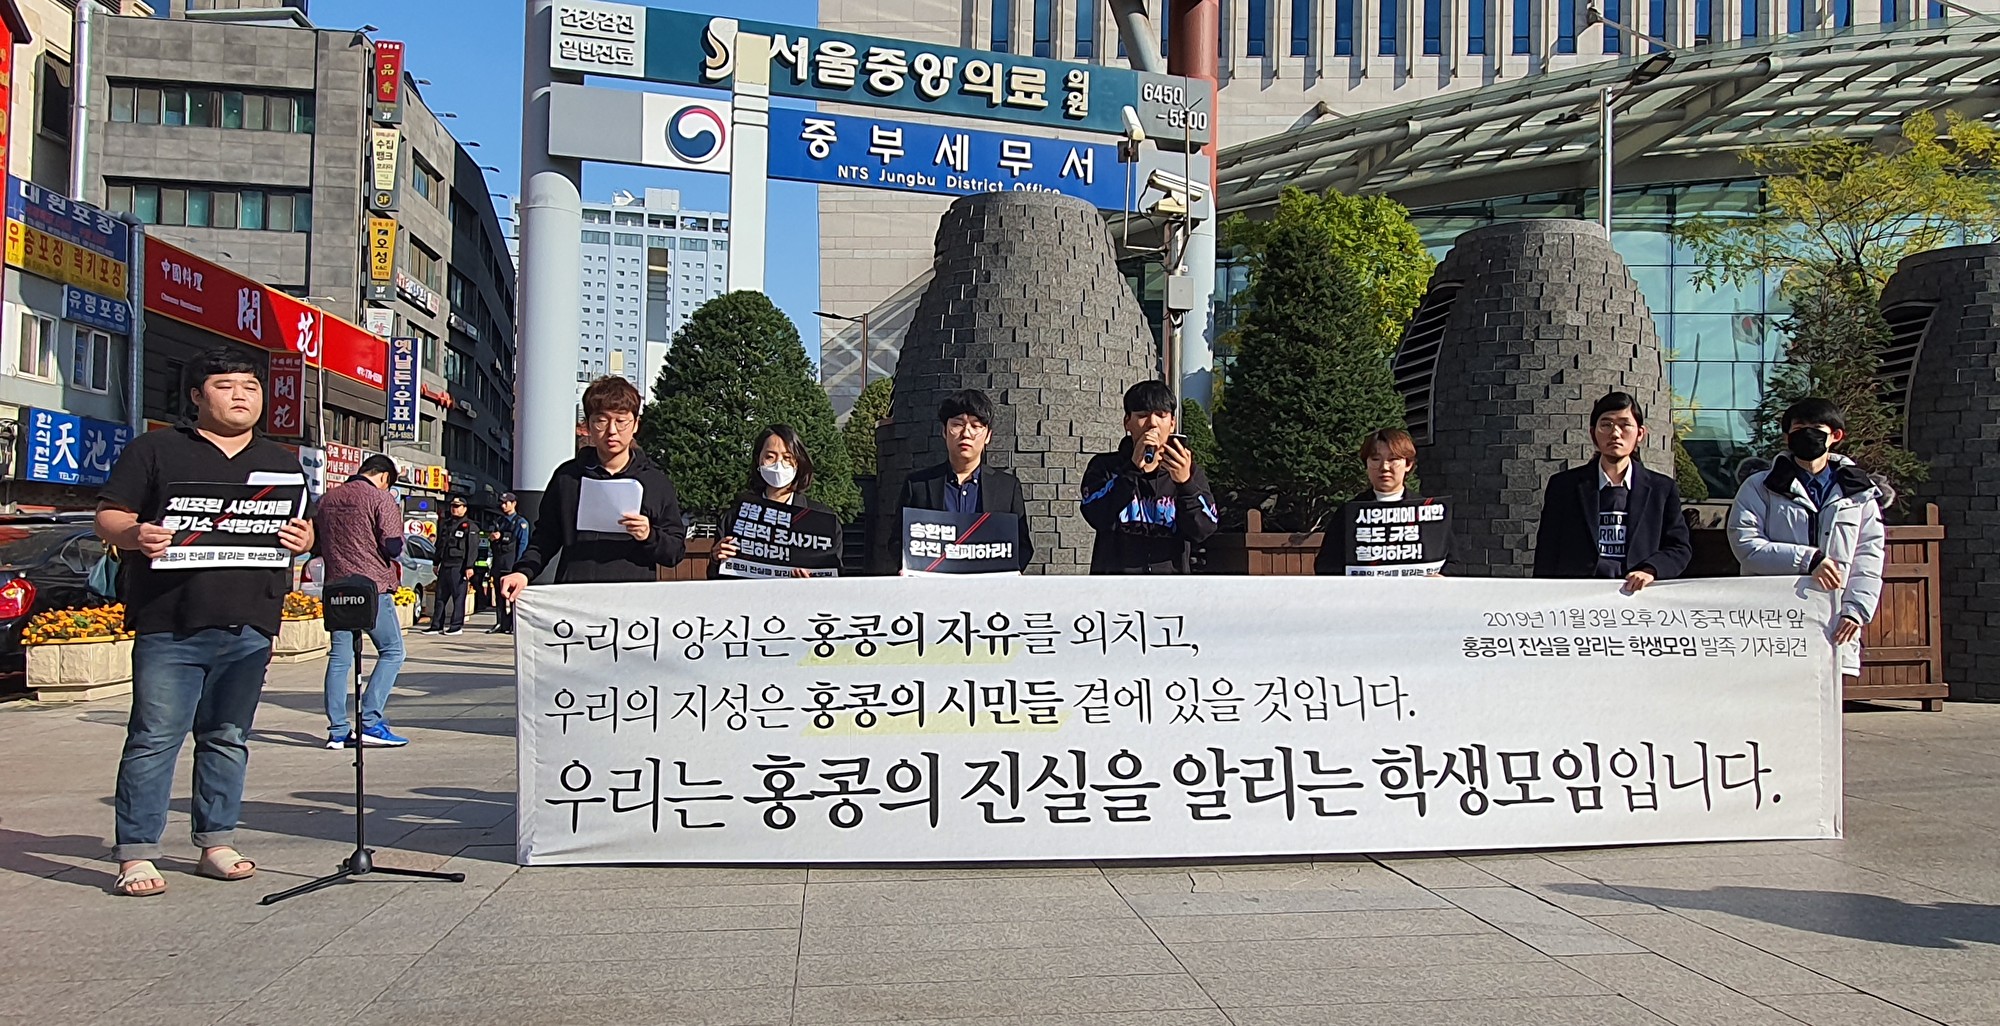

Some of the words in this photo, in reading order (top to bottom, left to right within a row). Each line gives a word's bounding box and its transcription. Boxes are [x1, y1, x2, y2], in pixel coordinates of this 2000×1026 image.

[560, 7, 634, 31] 건강검진
[560, 39, 634, 65] 일반진료
[770, 34, 1048, 108] 서울중앙의료
[1143, 83, 1183, 104] 6450
[376, 140, 394, 150] 수집
[801, 118, 1094, 184] 중부세무서
[838, 165, 869, 179] NTS
[879, 167, 936, 187] Jungbu
[946, 175, 1004, 191] District
[20, 180, 116, 235] 대원포장
[378, 195, 389, 204] 3F
[9, 223, 63, 267] 우송포장
[74, 248, 122, 287] 럭키포장
[375, 239, 389, 264] 오성
[376, 286, 386, 294] 3F
[165, 497, 224, 514] 체포된
[224, 499, 293, 515] 시위대를
[1355, 506, 1415, 524] 시위대에
[1418, 504, 1445, 522] 대한
[732, 519, 771, 542] 독립적
[773, 528, 833, 551] 조사기구
[909, 522, 957, 541] 송환법
[1355, 526, 1386, 543] 폭도
[909, 540, 941, 558] 완전
[944, 542, 1012, 559] 철폐하라!
[1355, 543, 1422, 561] 철회하라!
[1483, 611, 1544, 629] 2019년
[1549, 608, 1587, 629] 11월
[1588, 608, 1618, 629] 3일
[1620, 608, 1656, 628] 오후
[1657, 609, 1688, 628] 2시
[1690, 609, 1726, 629] 중국
[1728, 608, 1783, 629] 대사관
[1786, 608, 1806, 629] 앞
[543, 616, 660, 664] 우리의
[672, 614, 797, 661] 양심은
[801, 611, 924, 659] 홍콩의
[935, 610, 1062, 657] 자유를
[1069, 610, 1199, 657] 외치고,
[1461, 636, 1516, 658] 홍콩의
[1517, 636, 1571, 657] 진실을
[1573, 636, 1626, 657] 알리는
[1628, 635, 1698, 658] 학생모임
[1700, 636, 1737, 657] 발족
[1740, 636, 1807, 658] 기자회견
[544, 685, 659, 736] 우리의
[670, 682, 796, 733] 지성은
[800, 679, 925, 730] 홍콩의
[937, 678, 1065, 728] 시민들
[1072, 677, 1152, 725] 곁에
[1165, 676, 1246, 725] 있을
[1253, 675, 1416, 723] 것입니다.
[544, 756, 735, 834] 우리는
[742, 751, 940, 830] 홍콩의
[960, 748, 1161, 824] 진실을
[1172, 745, 1365, 822] 알리는
[1371, 740, 1781, 818] 학생모임입니다.
